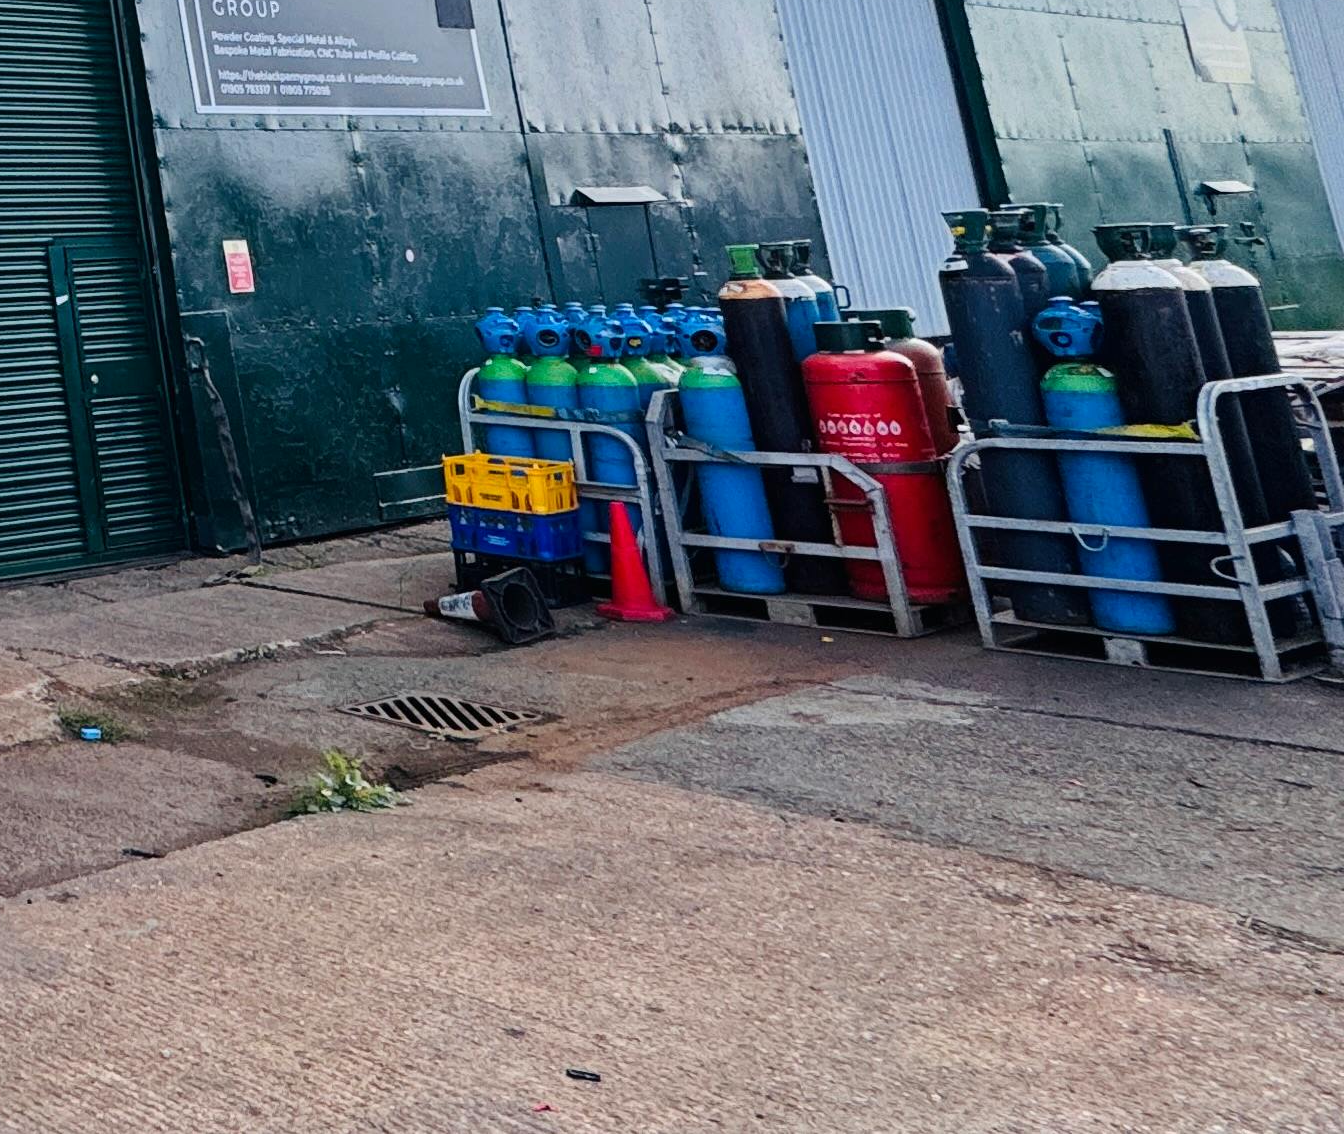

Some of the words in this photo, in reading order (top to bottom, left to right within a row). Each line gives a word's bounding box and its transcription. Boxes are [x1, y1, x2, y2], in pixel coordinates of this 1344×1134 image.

[211, 30, 242, 42] Powder
[277, 33, 305, 45] Special
[305, 33, 327, 45] Metal
[327, 35, 334, 45] &
[213, 44, 249, 57] Bespoke
[249, 45, 272, 56] Metal
[317, 47, 335, 58] CNC
[335, 48, 353, 59] Tube
[354, 50, 367, 59] and
[368, 50, 391, 61] Profile
